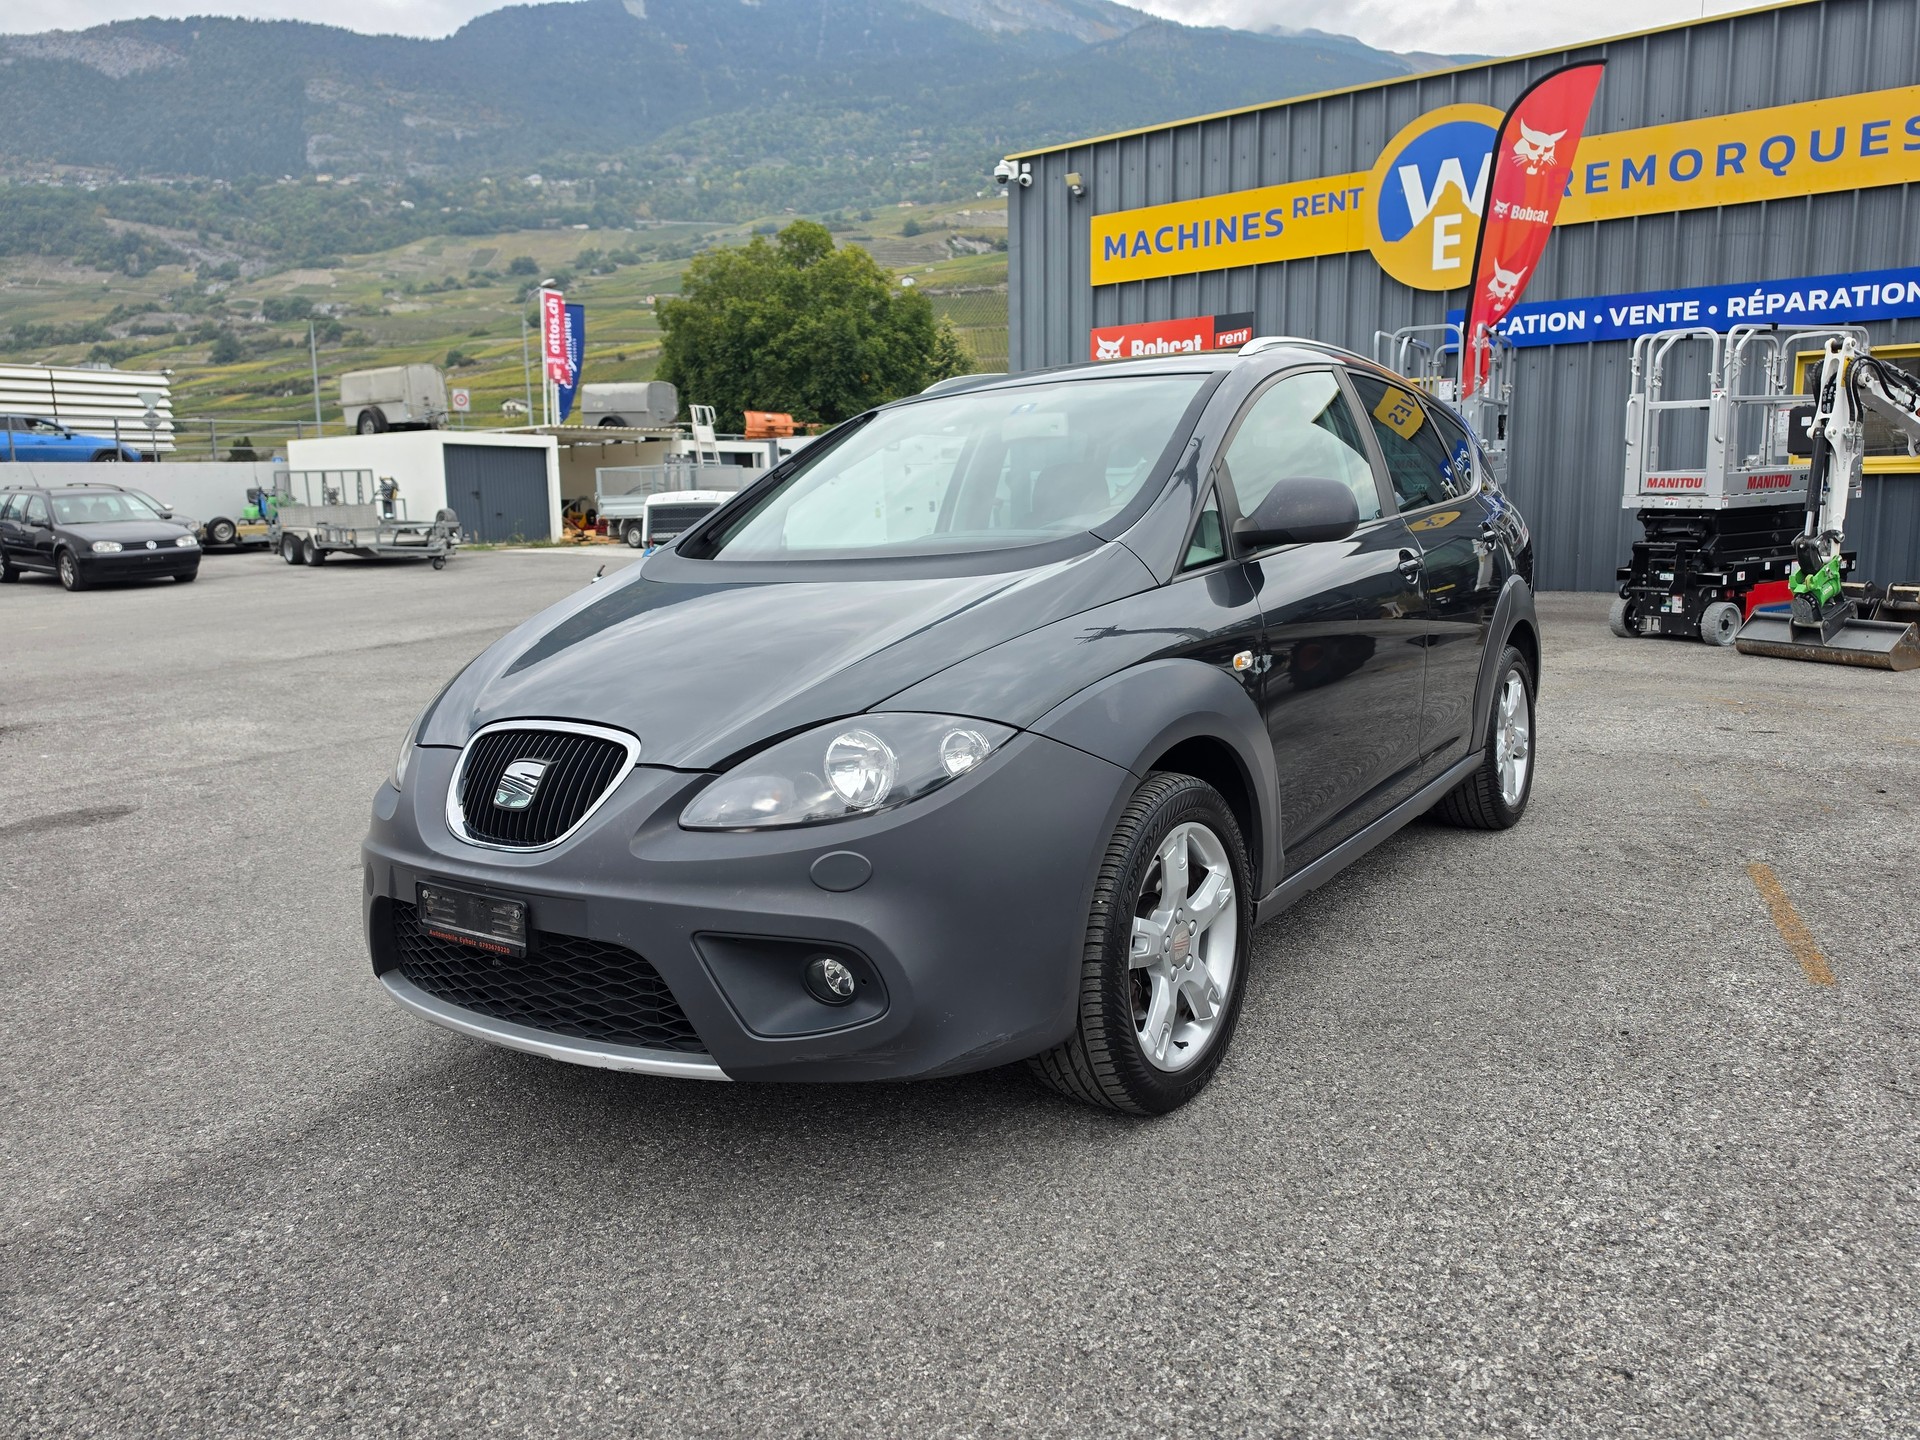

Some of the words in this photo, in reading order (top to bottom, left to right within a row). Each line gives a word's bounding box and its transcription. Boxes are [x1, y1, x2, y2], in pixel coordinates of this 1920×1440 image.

[1103, 208, 1284, 262] MACHINES
[1293, 187, 1364, 218] RENT
[1432, 213, 1462, 271] E
[547, 298, 561, 354] ottos.ch
[1459, 310, 1586, 338] CATION
[1609, 300, 1700, 328] VENTE
[1727, 281, 1920, 318] RÉPARATION
[1218, 329, 1249, 346] rent
[1646, 477, 1703, 489] MANITOU
[1746, 474, 1793, 490] MANITOU
[429, 929, 458, 942] Automobile
